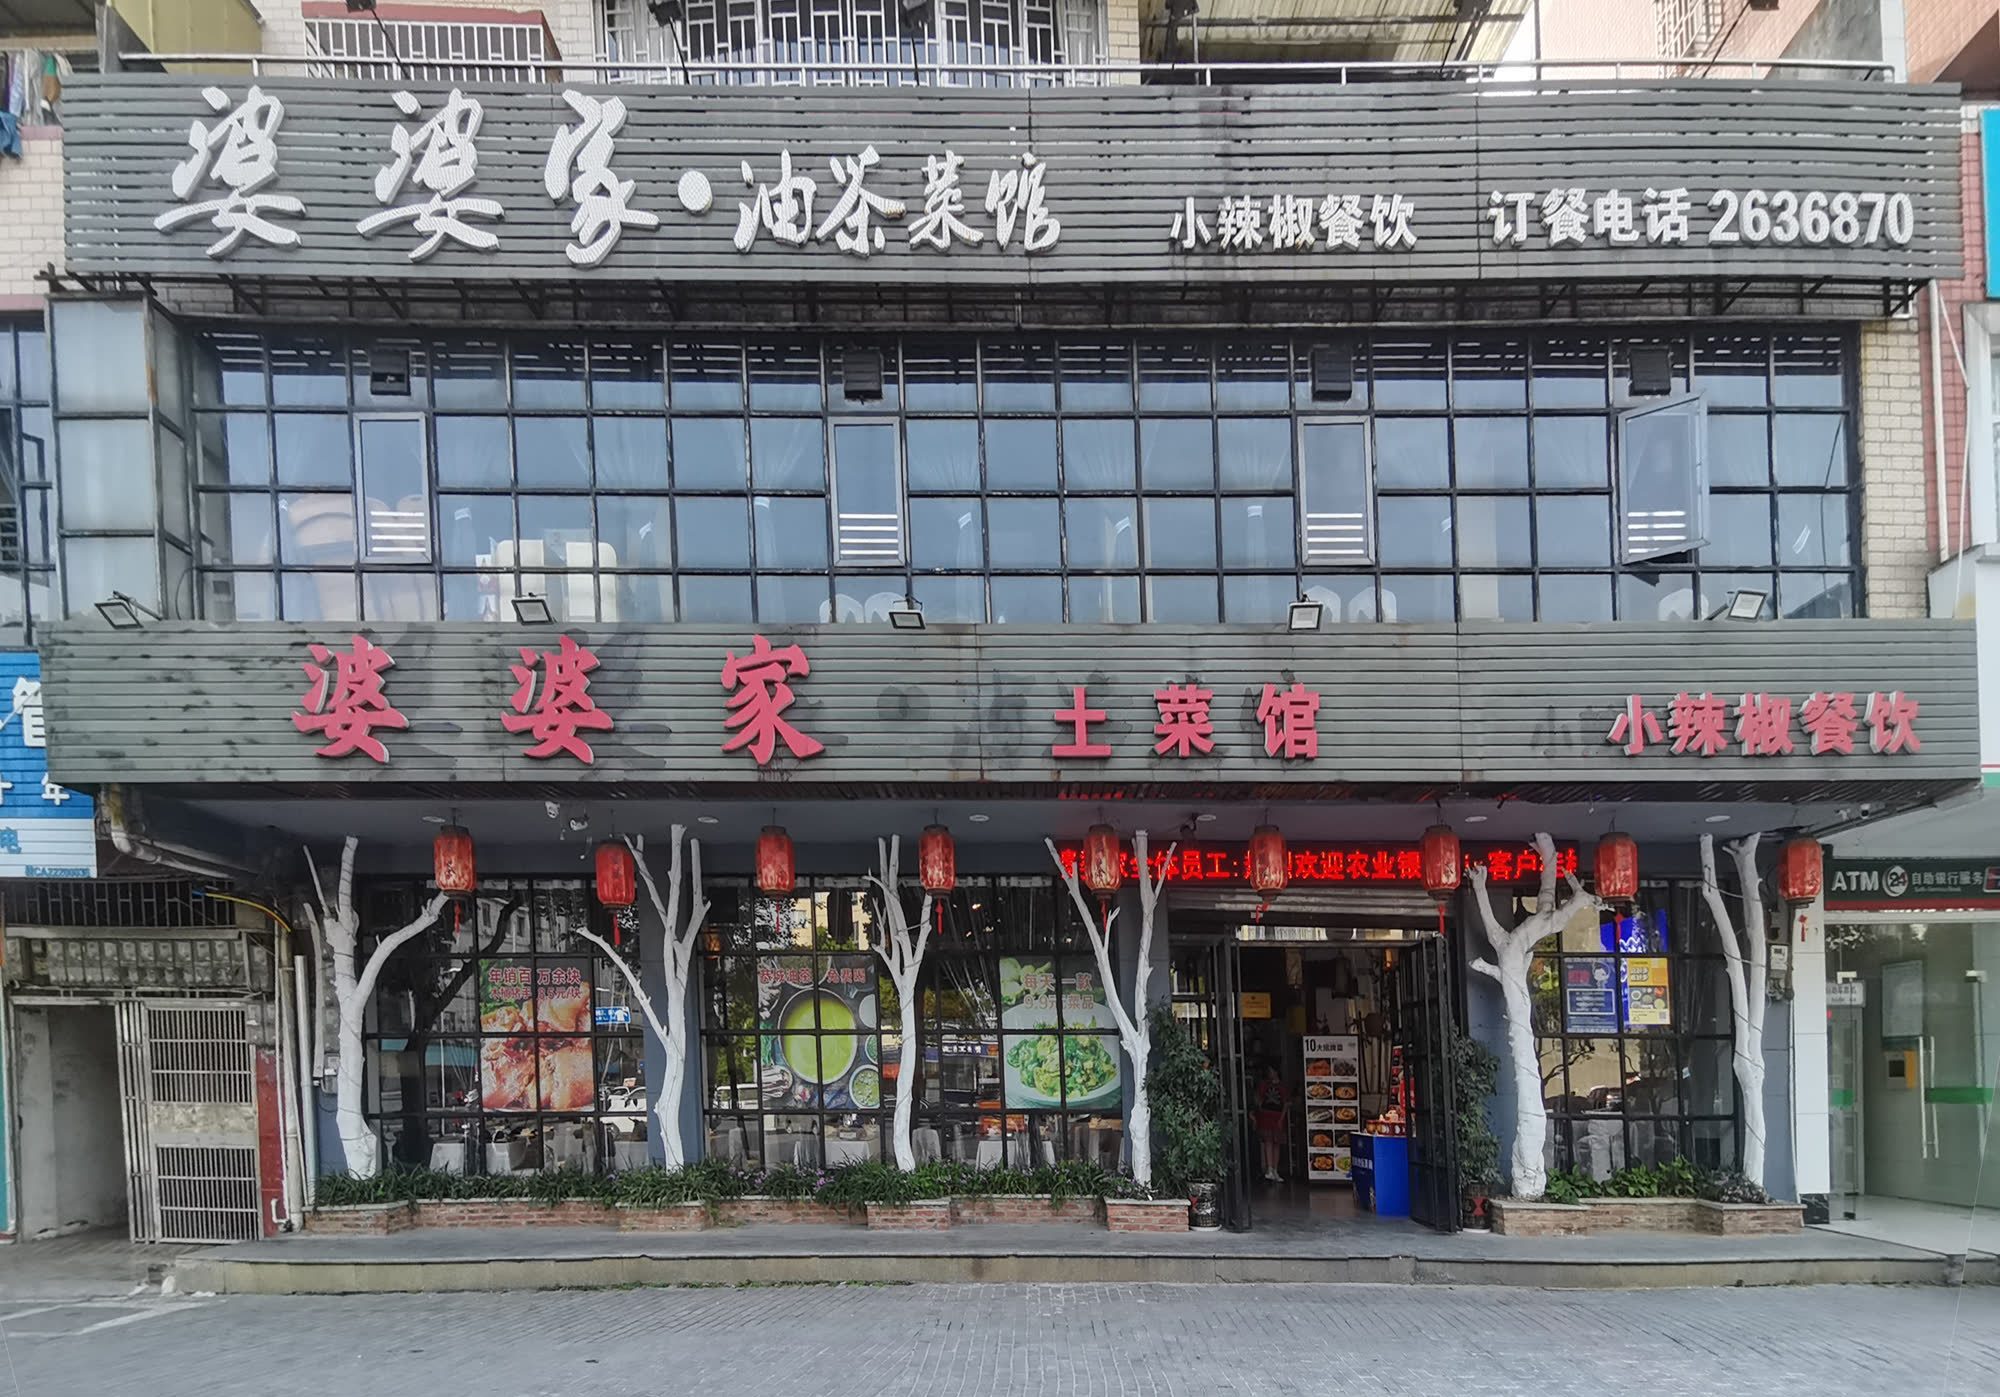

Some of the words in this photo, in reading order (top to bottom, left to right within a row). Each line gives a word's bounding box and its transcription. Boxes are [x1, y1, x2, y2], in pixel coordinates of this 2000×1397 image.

[733, 144, 1062, 258] 油茶菜馆
[1169, 194, 1418, 251] 小辣椒餐饮
[1487, 188, 1692, 247] 订餐电话
[1707, 188, 1916, 246] 2636870
[291, 634, 827, 766] 婆婆家
[1051, 682, 1321, 760] 土菜馆
[1605, 690, 1922, 758] 小辣椒餐饮
[1831, 871, 1879, 892] ATM
[1911, 871, 1984, 886] 自助银行服务
